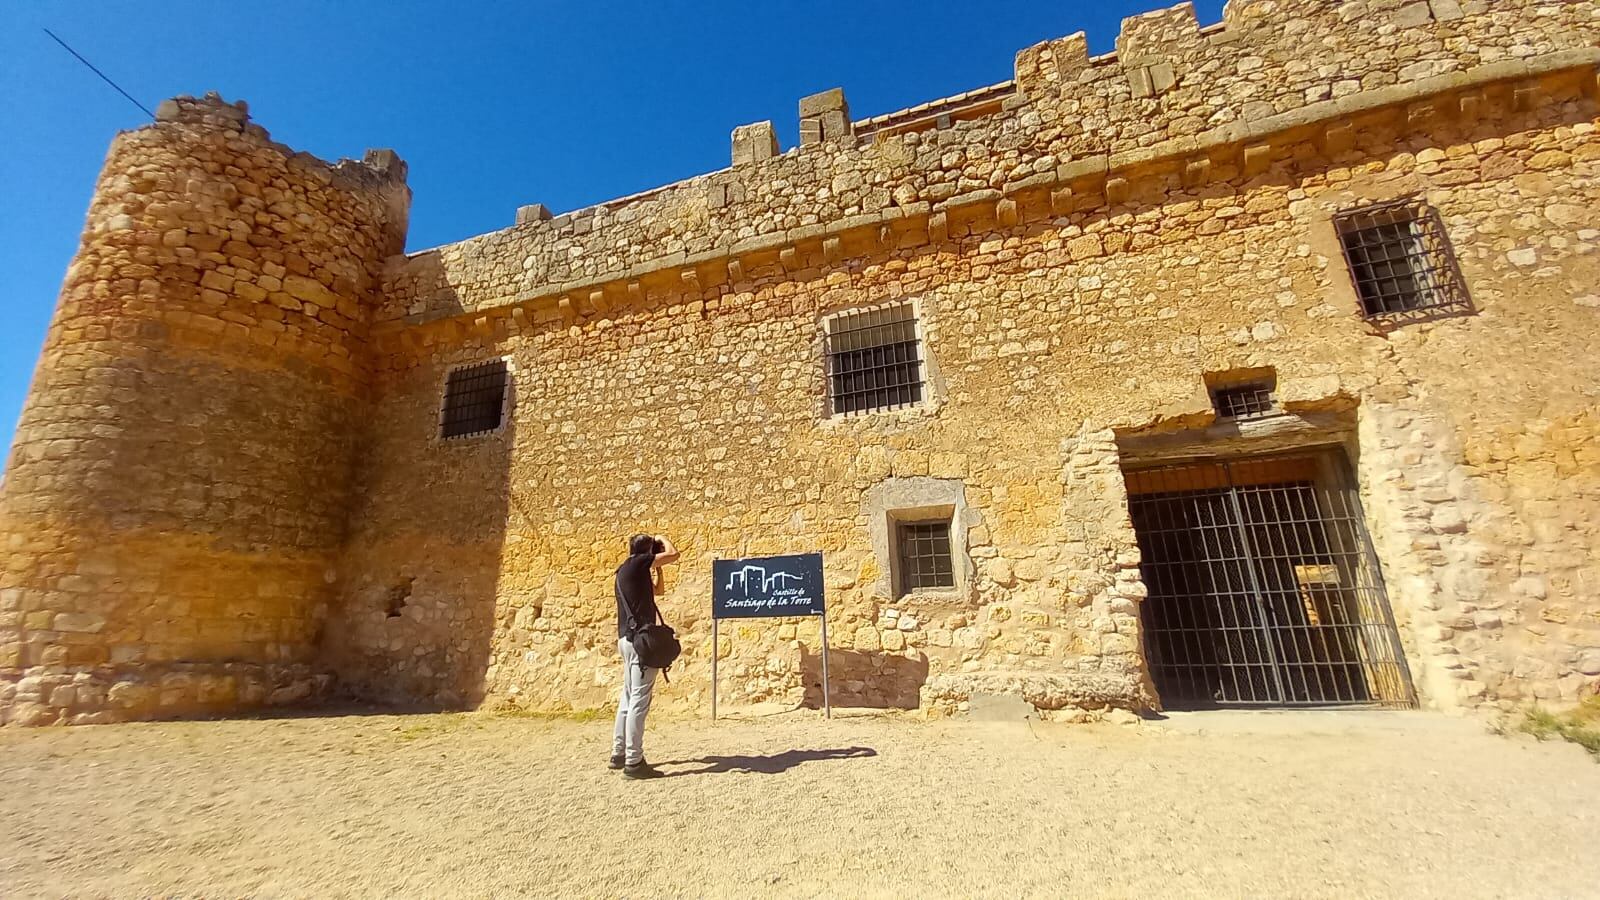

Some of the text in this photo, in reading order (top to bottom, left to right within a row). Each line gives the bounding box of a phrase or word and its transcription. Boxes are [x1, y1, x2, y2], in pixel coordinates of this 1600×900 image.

[772, 587, 805, 597] Castillo de
[724, 597, 765, 612] Santiago
[766, 597, 777, 609] de
[790, 595, 812, 605] Torre
